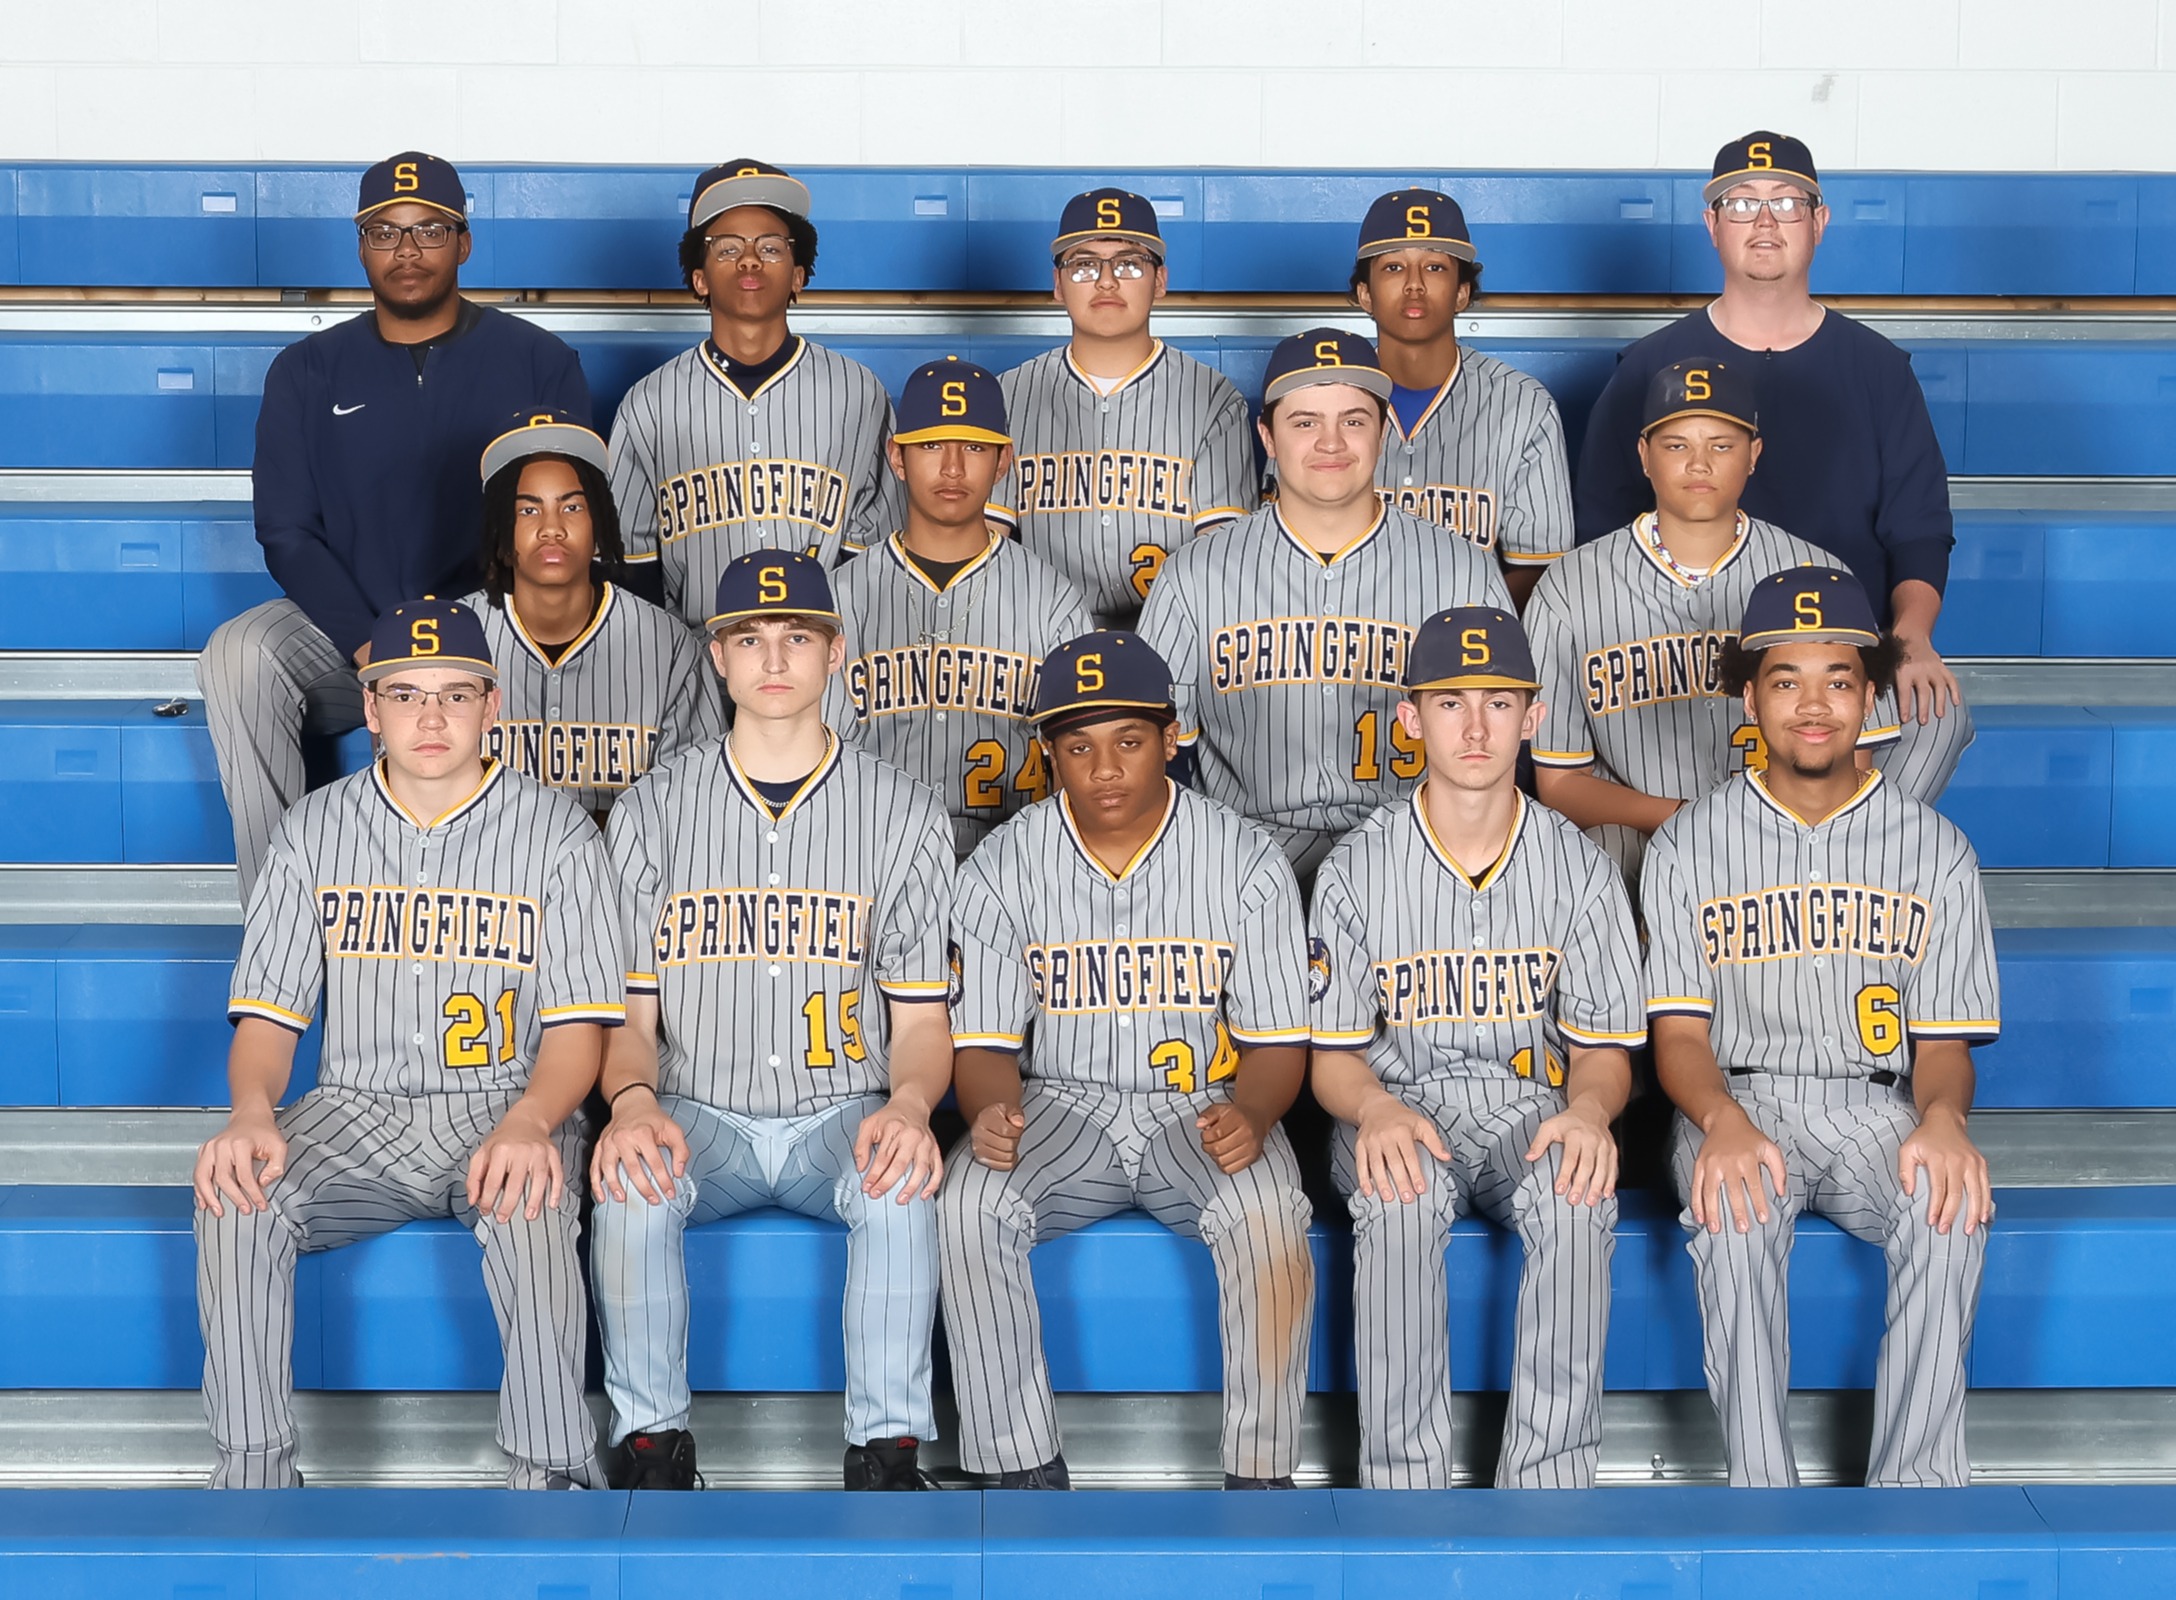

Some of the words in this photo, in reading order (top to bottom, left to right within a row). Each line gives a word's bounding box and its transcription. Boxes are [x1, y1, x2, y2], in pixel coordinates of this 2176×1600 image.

[1747, 141, 1773, 170] S
[393, 162, 419, 192] S
[1096, 198, 1122, 229] S
[1405, 205, 1432, 238] S
[1314, 340, 1342, 367] S
[941, 381, 967, 417] S
[1685, 369, 1712, 401] S
[758, 566, 788, 604] S
[1794, 591, 1823, 630] S
[411, 618, 441, 656] S
[1210, 616, 1416, 694] SPRINGFIEL
[1460, 628, 1491, 667] S
[1075, 653, 1105, 694] S
[1353, 710, 1427, 782] 19
[964, 739, 1047, 809] 24
[654, 888, 874, 969] SPRINGFIEL
[1698, 883, 1931, 971] SPRINGFIELD
[443, 988, 516, 1069] 21
[801, 988, 866, 1069] 15
[1855, 984, 1901, 1057] 6
[1148, 1019, 1241, 1092] 34
